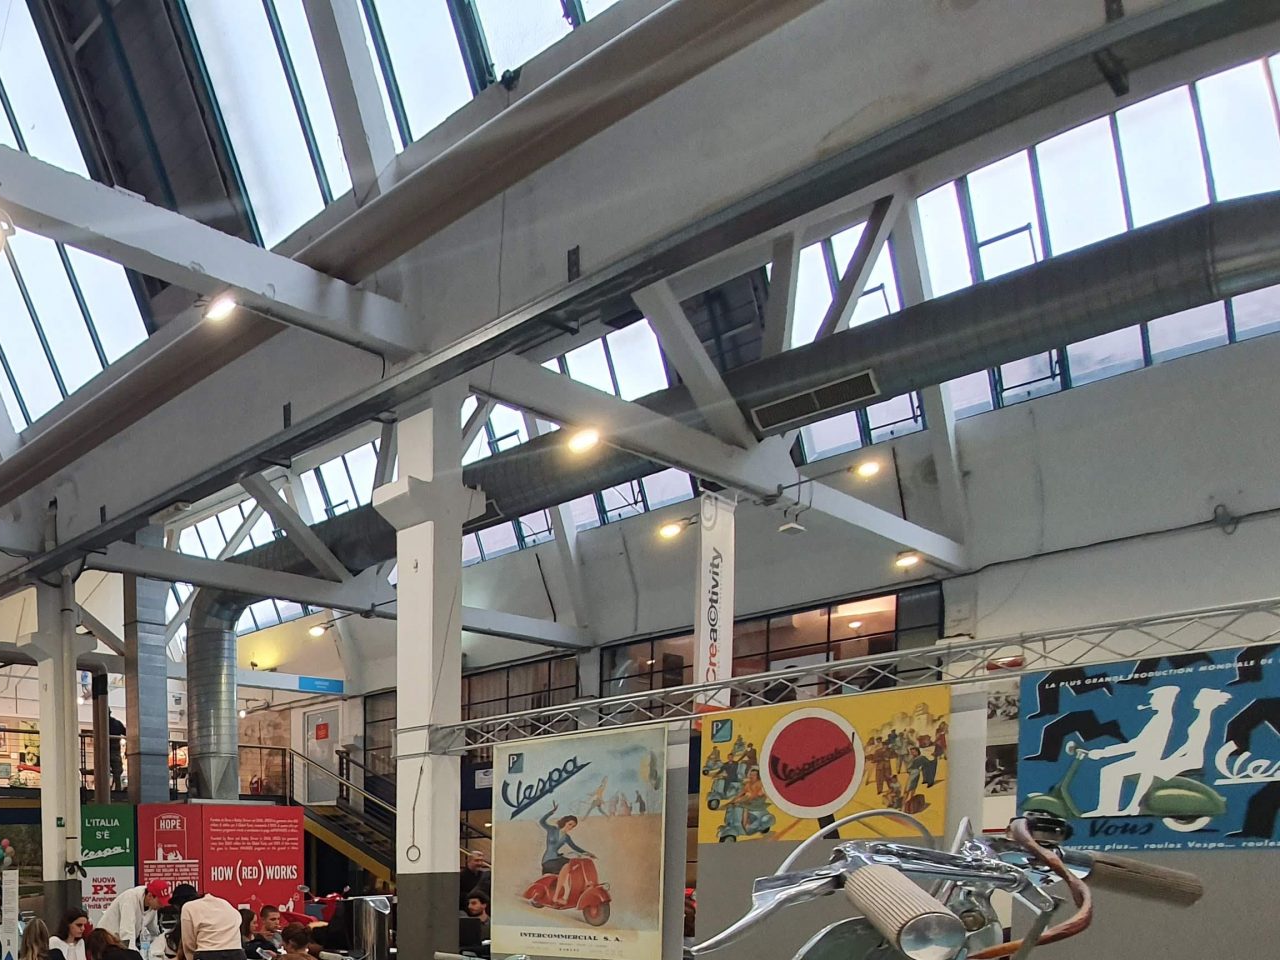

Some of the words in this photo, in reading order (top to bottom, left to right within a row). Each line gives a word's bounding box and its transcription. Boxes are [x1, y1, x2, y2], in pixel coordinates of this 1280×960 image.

[501, 755, 592, 821] Vespa
[85, 818, 120, 827] L'ITALIA
[160, 819, 181, 829] HOPE
[1089, 818, 1155, 838] Vous
[211, 866, 233, 881] HOW
[236, 859, 264, 886] (RED)
[265, 865, 298, 880] WORKS
[92, 876, 116, 884] NUOVA
[91, 884, 118, 895] PX
[520, 932, 598, 941] INTERCOMMERCIAL
